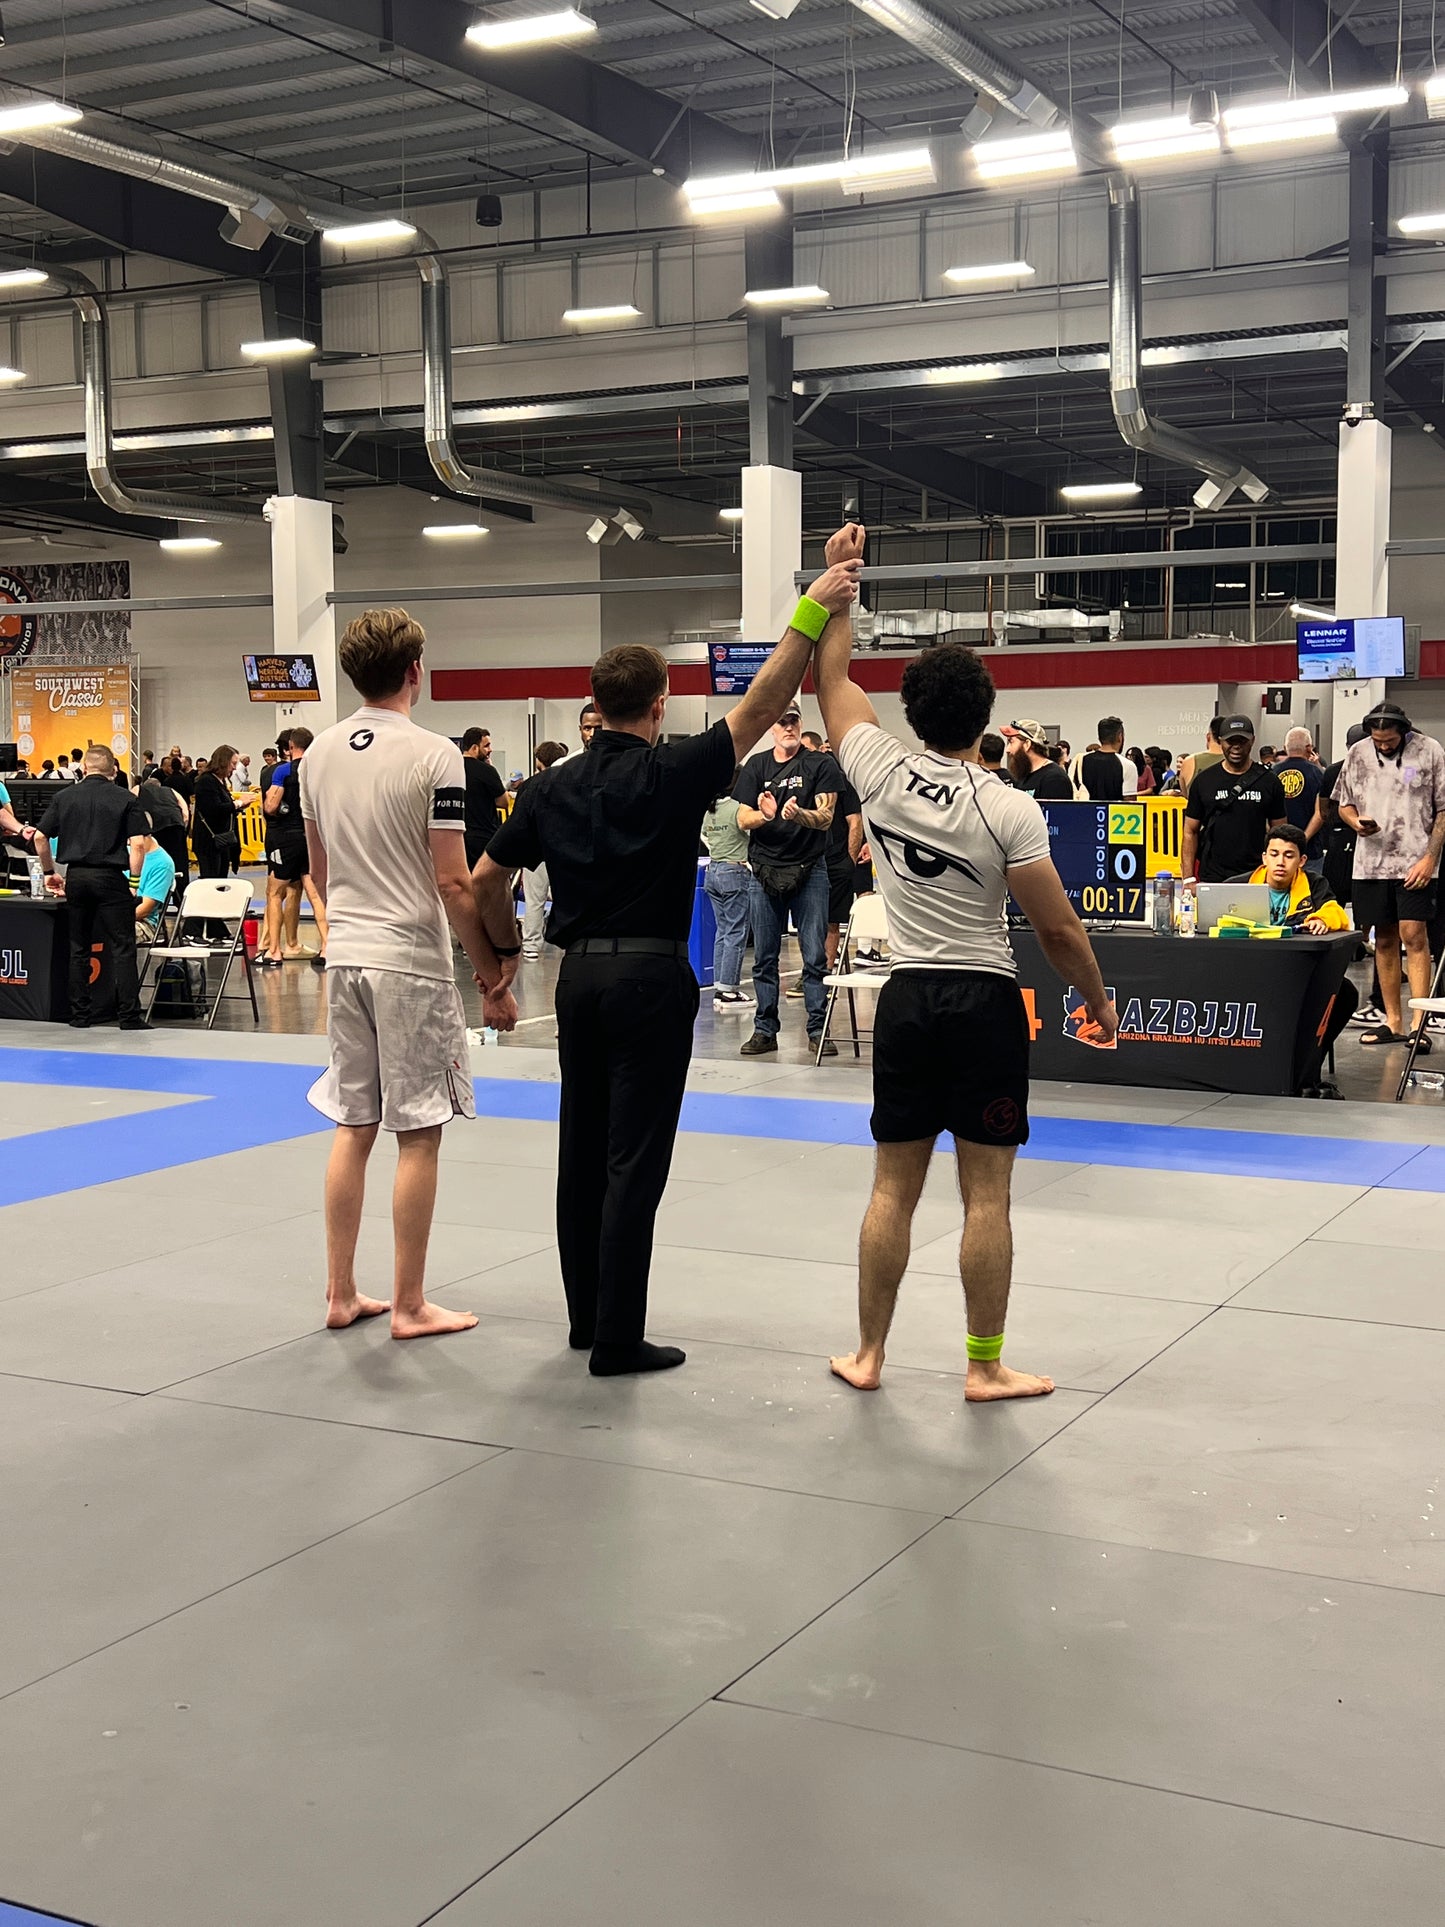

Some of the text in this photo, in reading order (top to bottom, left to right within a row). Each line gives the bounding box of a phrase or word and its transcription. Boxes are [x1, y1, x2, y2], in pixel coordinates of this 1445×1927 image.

[1303, 628, 1348, 638] LENNAR
[257, 658, 286, 667] HARVEST
[35, 677, 105, 691] SOUTHWEST
[49, 686, 104, 712] Classic
[1179, 711, 1209, 722] MEN'S
[436, 799, 452, 808] FOR
[1111, 813, 1141, 835] 22
[1114, 849, 1137, 880] 0
[1082, 886, 1142, 914] 00:17
[1118, 998, 1264, 1039] AZBJJL
[1117, 1032, 1151, 1042] ARIZONA
[1152, 1033, 1193, 1044] BRAZILIAN
[1230, 1038, 1262, 1048] LEAGUE
